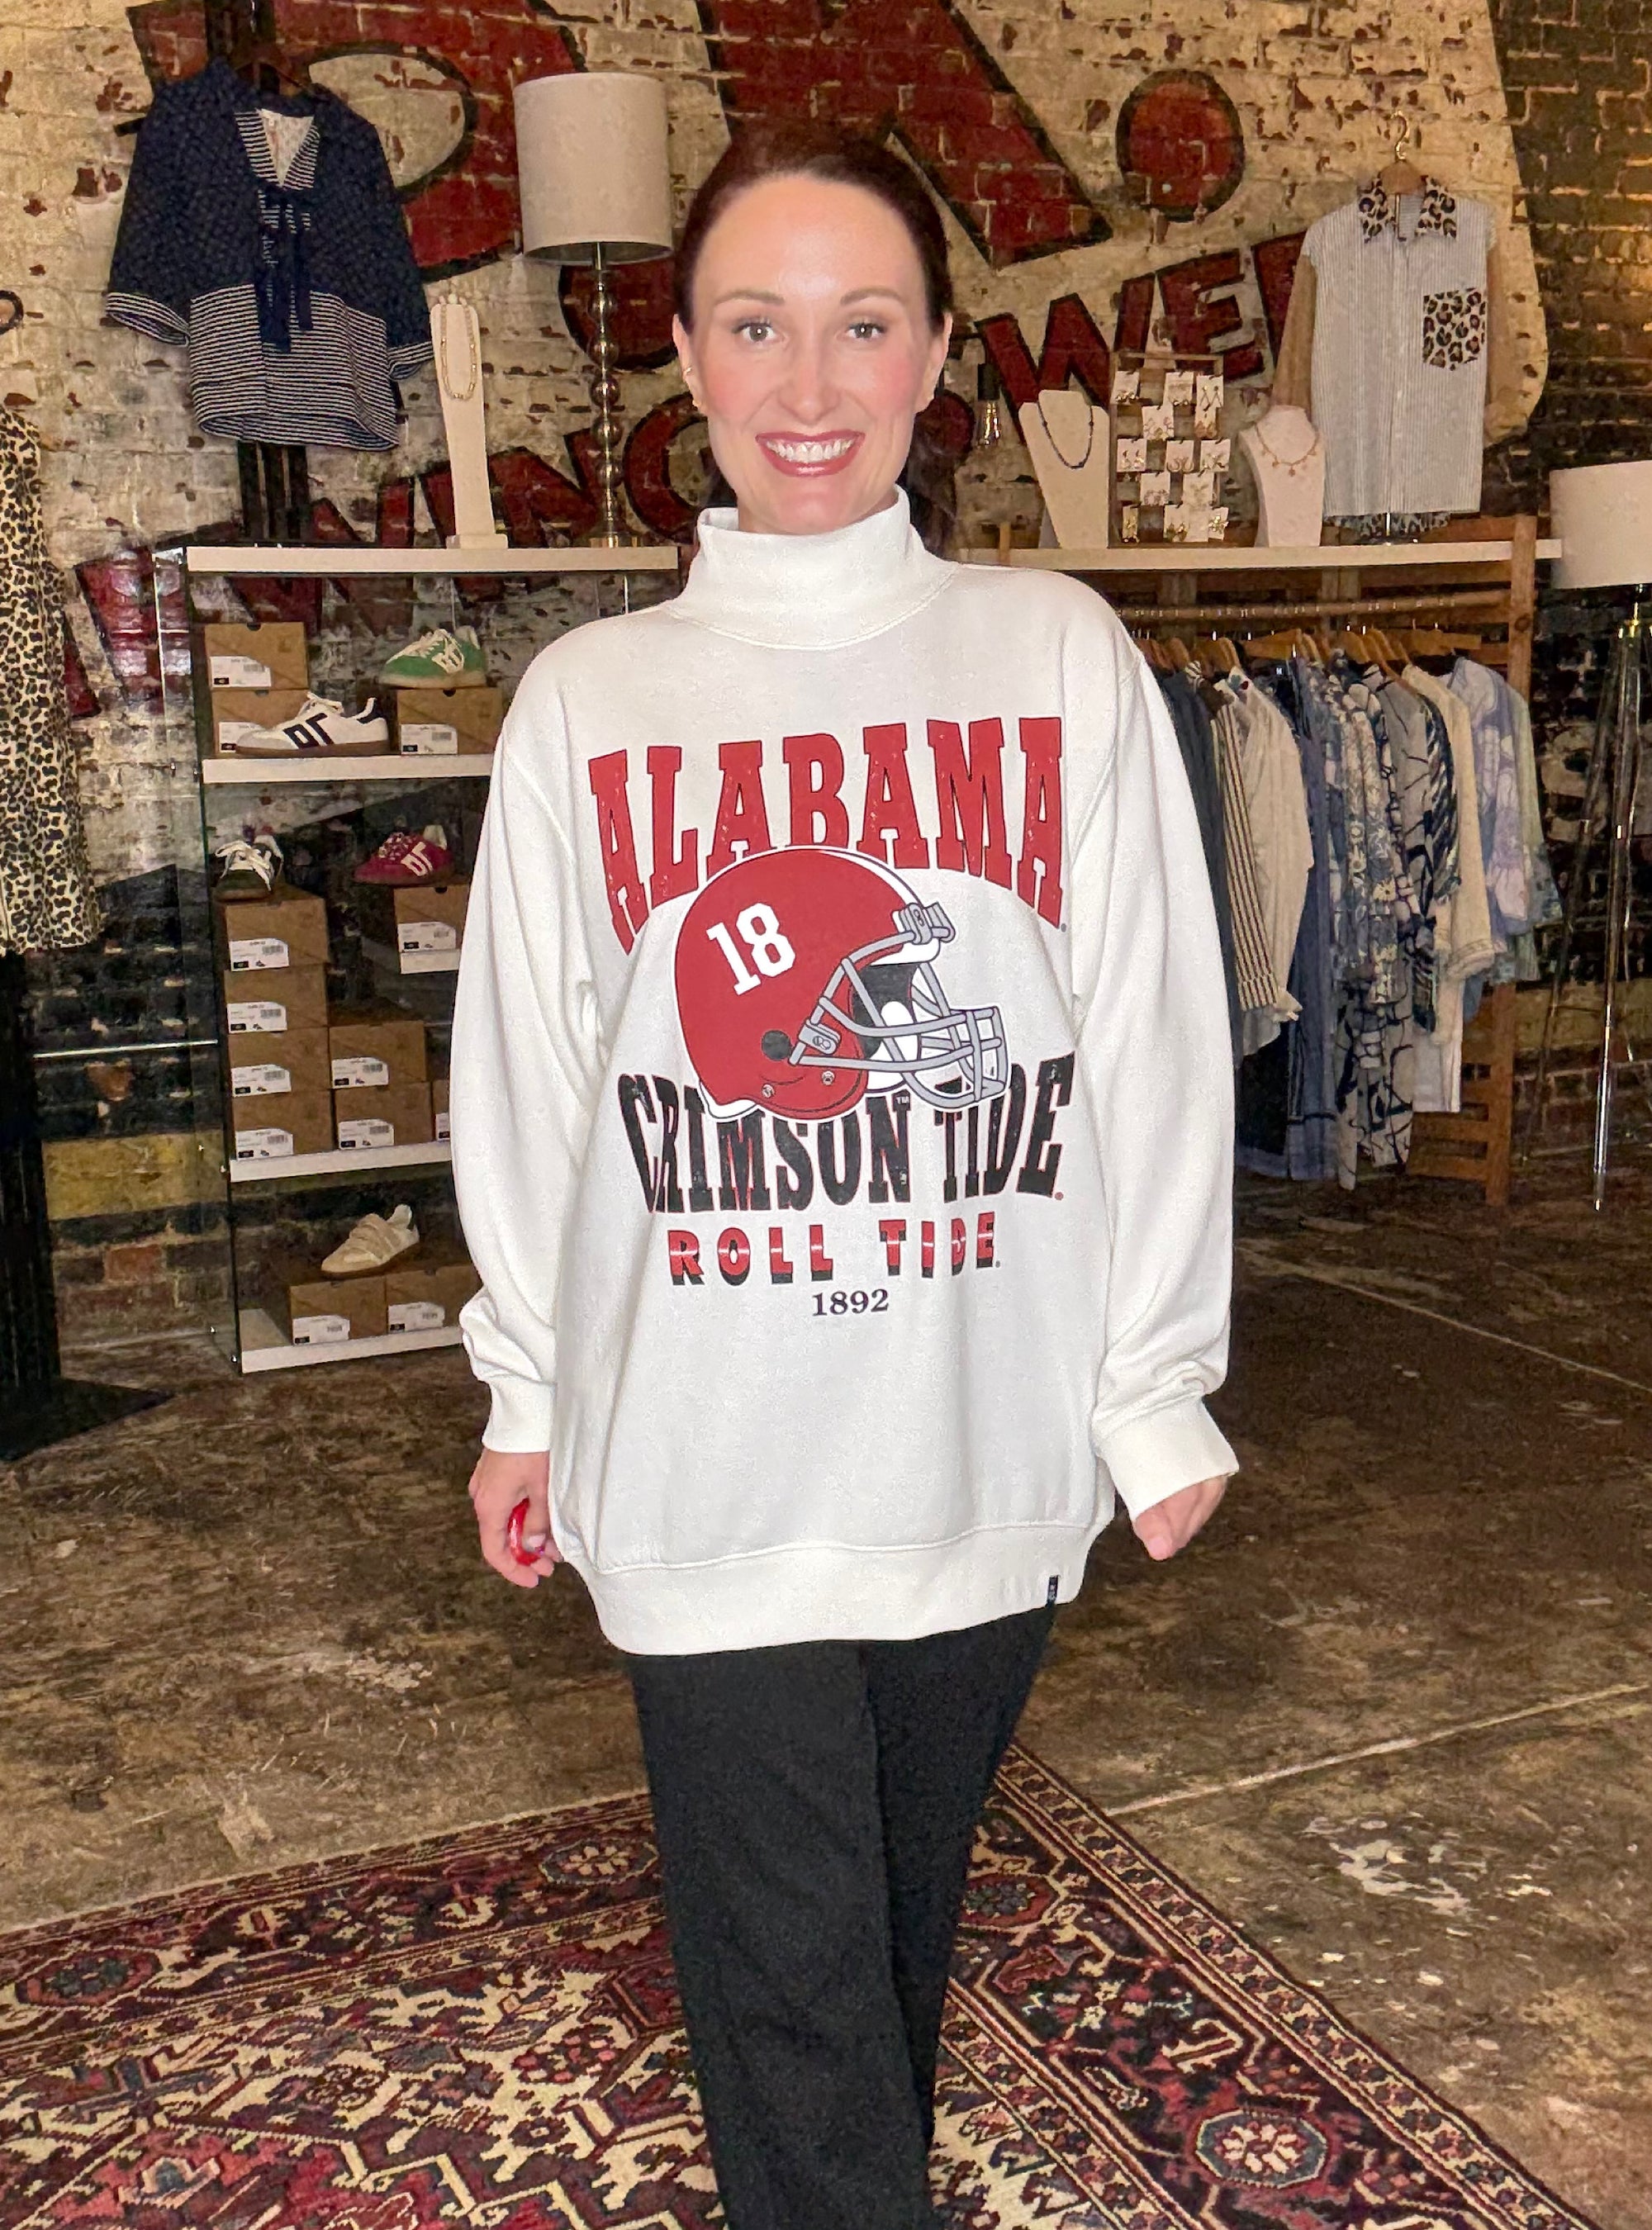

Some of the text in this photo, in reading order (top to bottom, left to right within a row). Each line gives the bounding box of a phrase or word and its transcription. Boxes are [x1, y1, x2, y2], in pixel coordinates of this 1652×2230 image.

[588, 717, 1063, 955] ALABAMA
[706, 902, 796, 994] 18
[618, 1053, 1076, 1214] CRIMSON TIDE
[667, 1212, 996, 1286] ROLL TIDE
[813, 1288, 890, 1317] 1892
